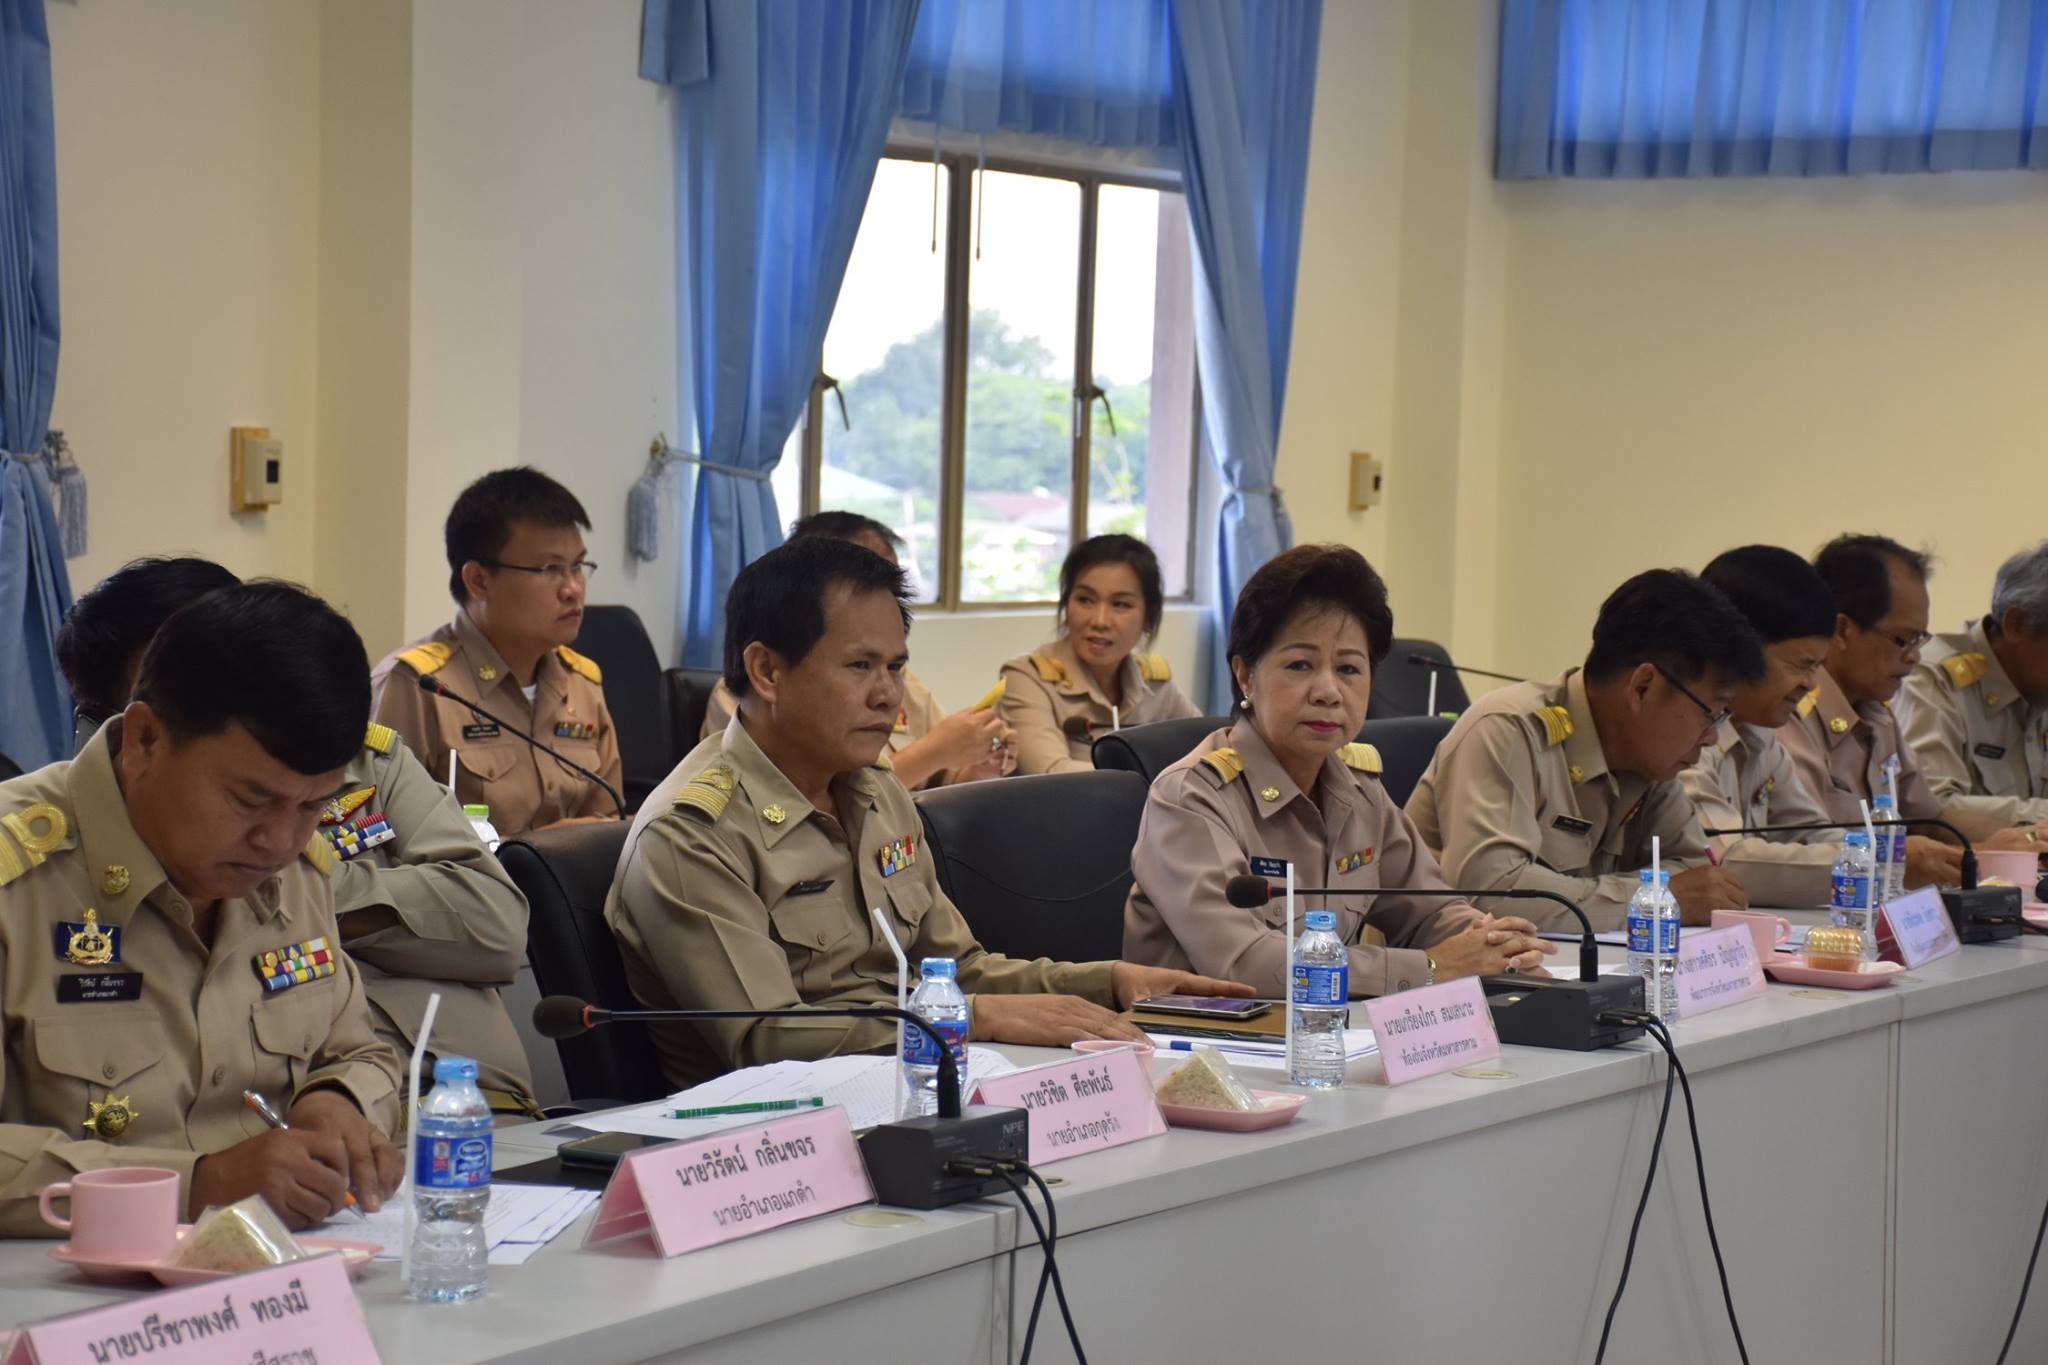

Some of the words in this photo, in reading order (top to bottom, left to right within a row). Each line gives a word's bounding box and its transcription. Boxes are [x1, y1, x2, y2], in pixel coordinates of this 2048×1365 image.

[1020, 1079, 1068, 1110] นายวิชิต
[1003, 1120, 1024, 1135] NPE
[676, 1143, 748, 1186] นายวิรัตน์
[756, 1131, 816, 1168] กลิ่นขจร
[713, 1180, 816, 1227] นายอำเภอแกดำ
[88, 1295, 239, 1364] นายปรีชาพงศ์
[250, 1278, 310, 1322] ทองมี
